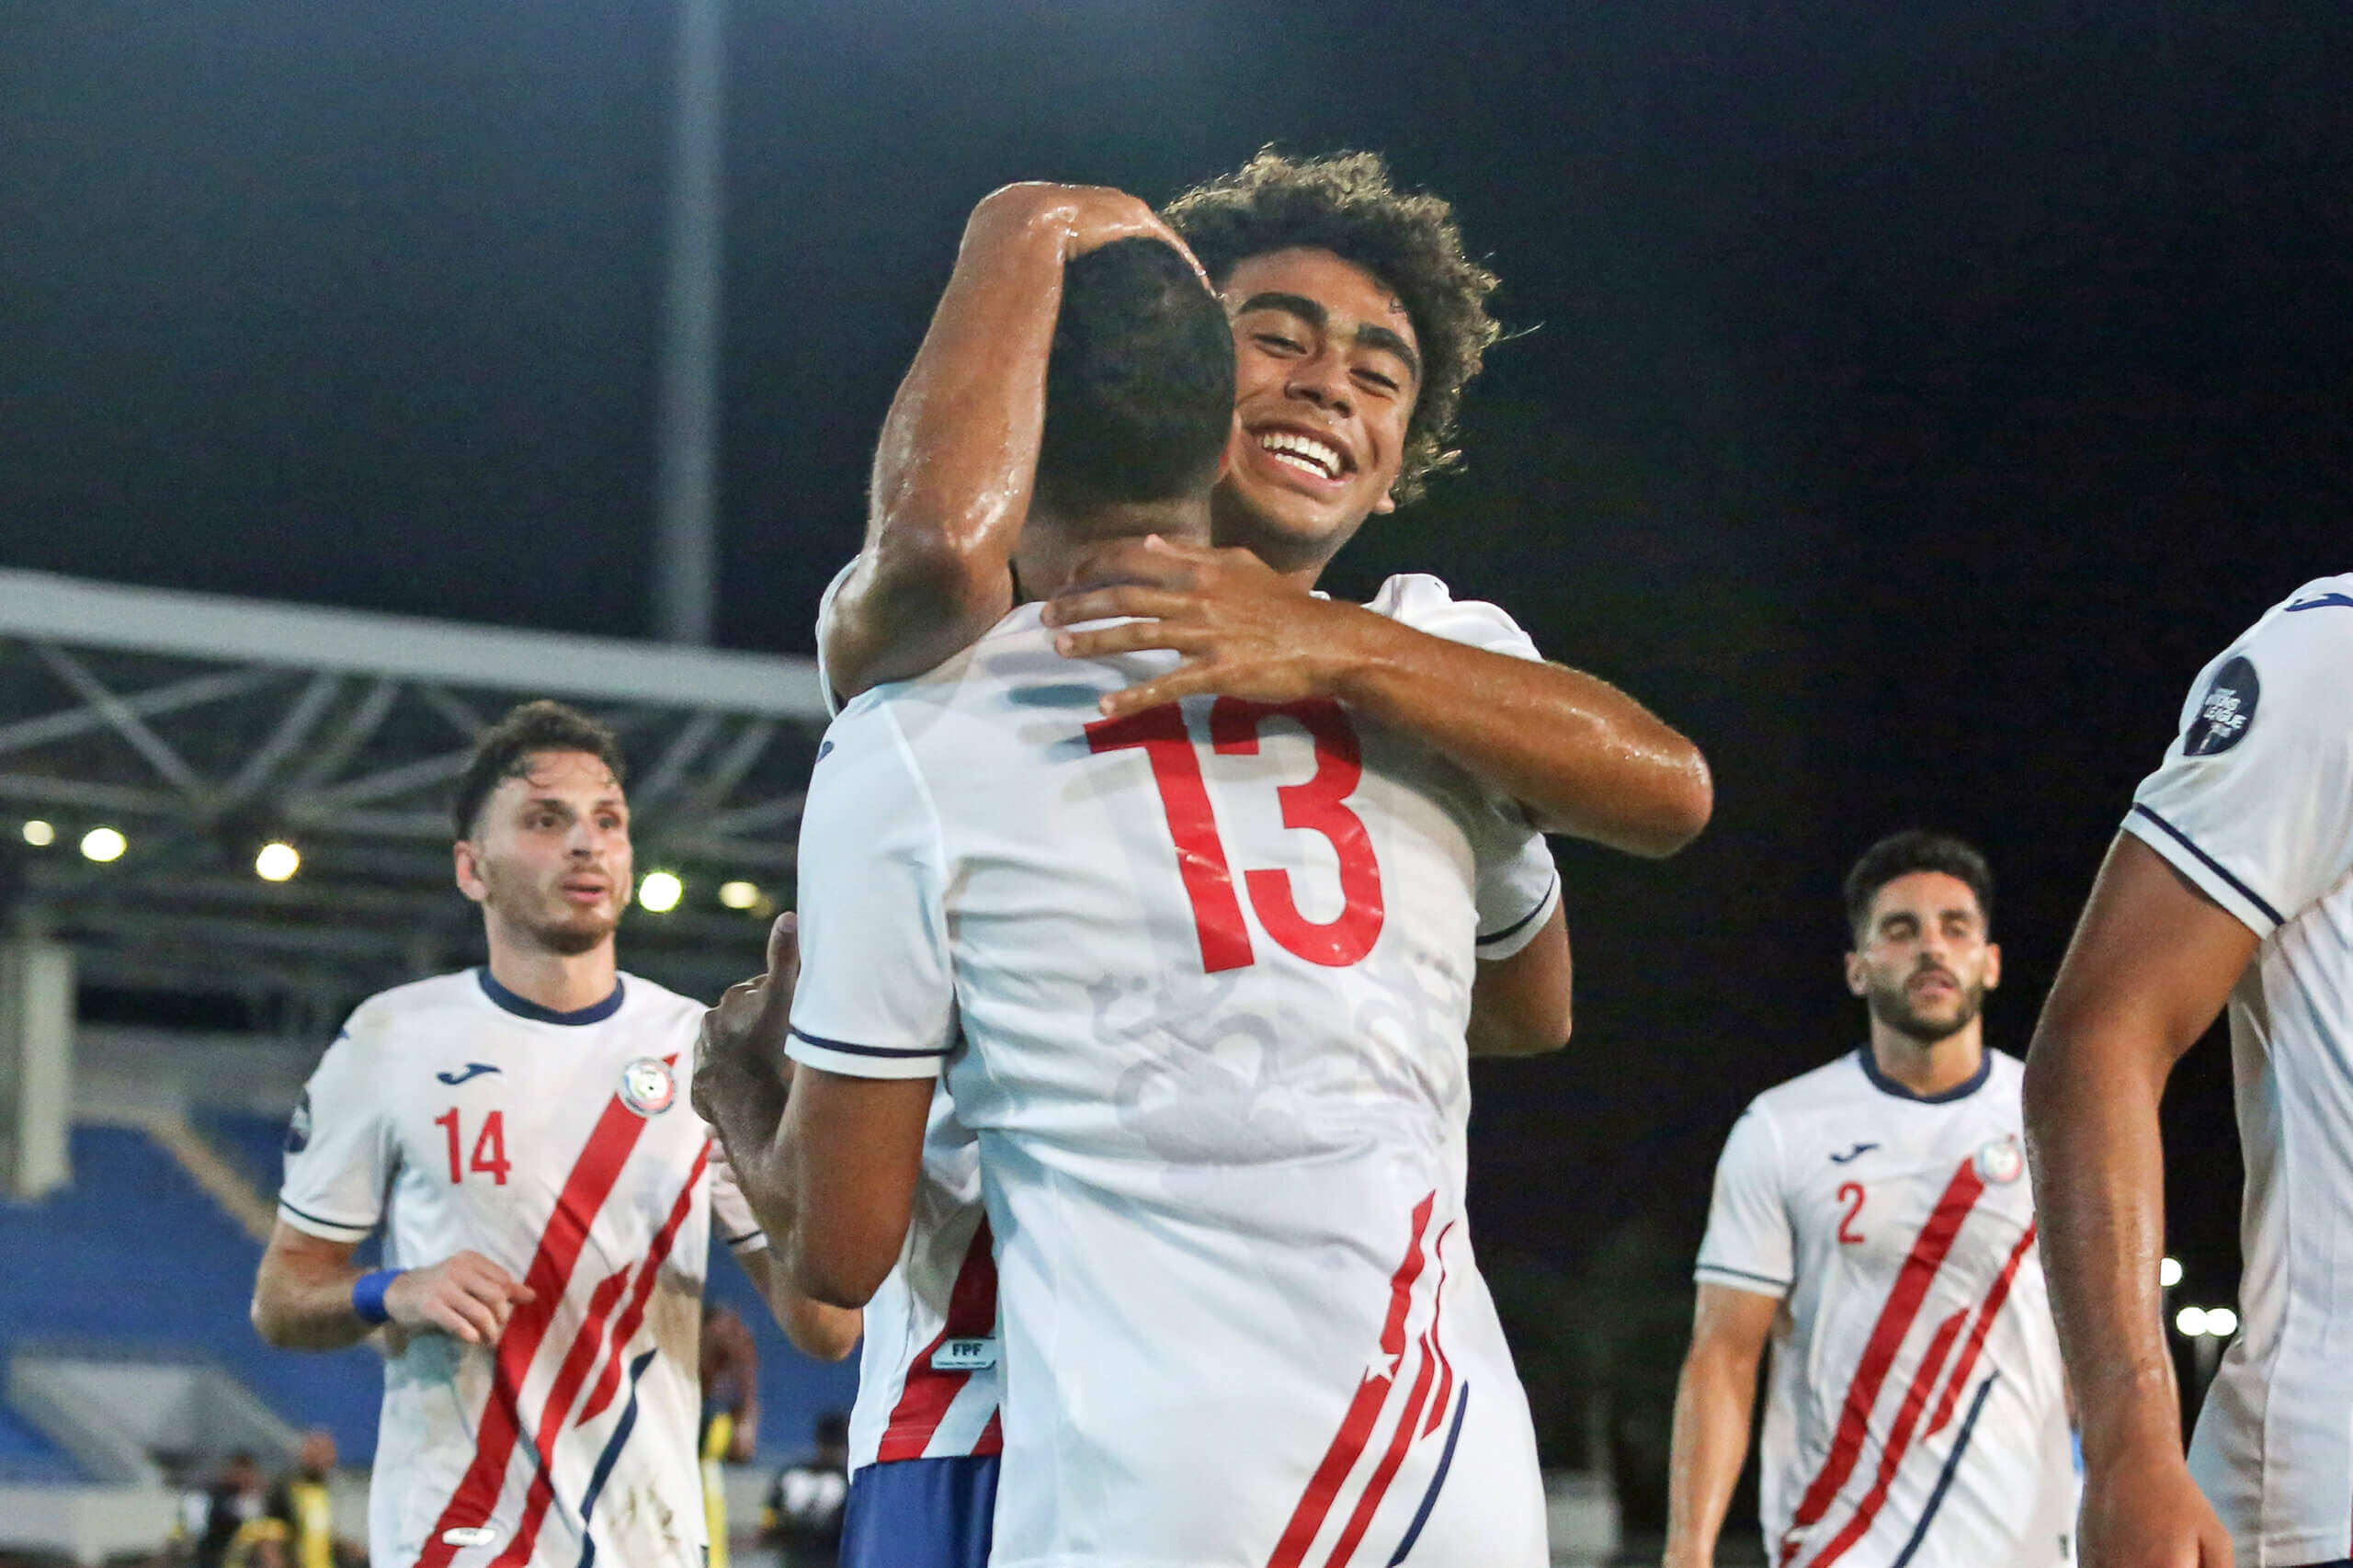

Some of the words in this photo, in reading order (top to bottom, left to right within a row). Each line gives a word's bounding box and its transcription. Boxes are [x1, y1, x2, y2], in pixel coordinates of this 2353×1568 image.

[1084, 695, 1384, 973] 13
[435, 1107, 511, 1185] 14
[1837, 1180, 1865, 1244] 2
[951, 1343, 983, 1357] FPF
